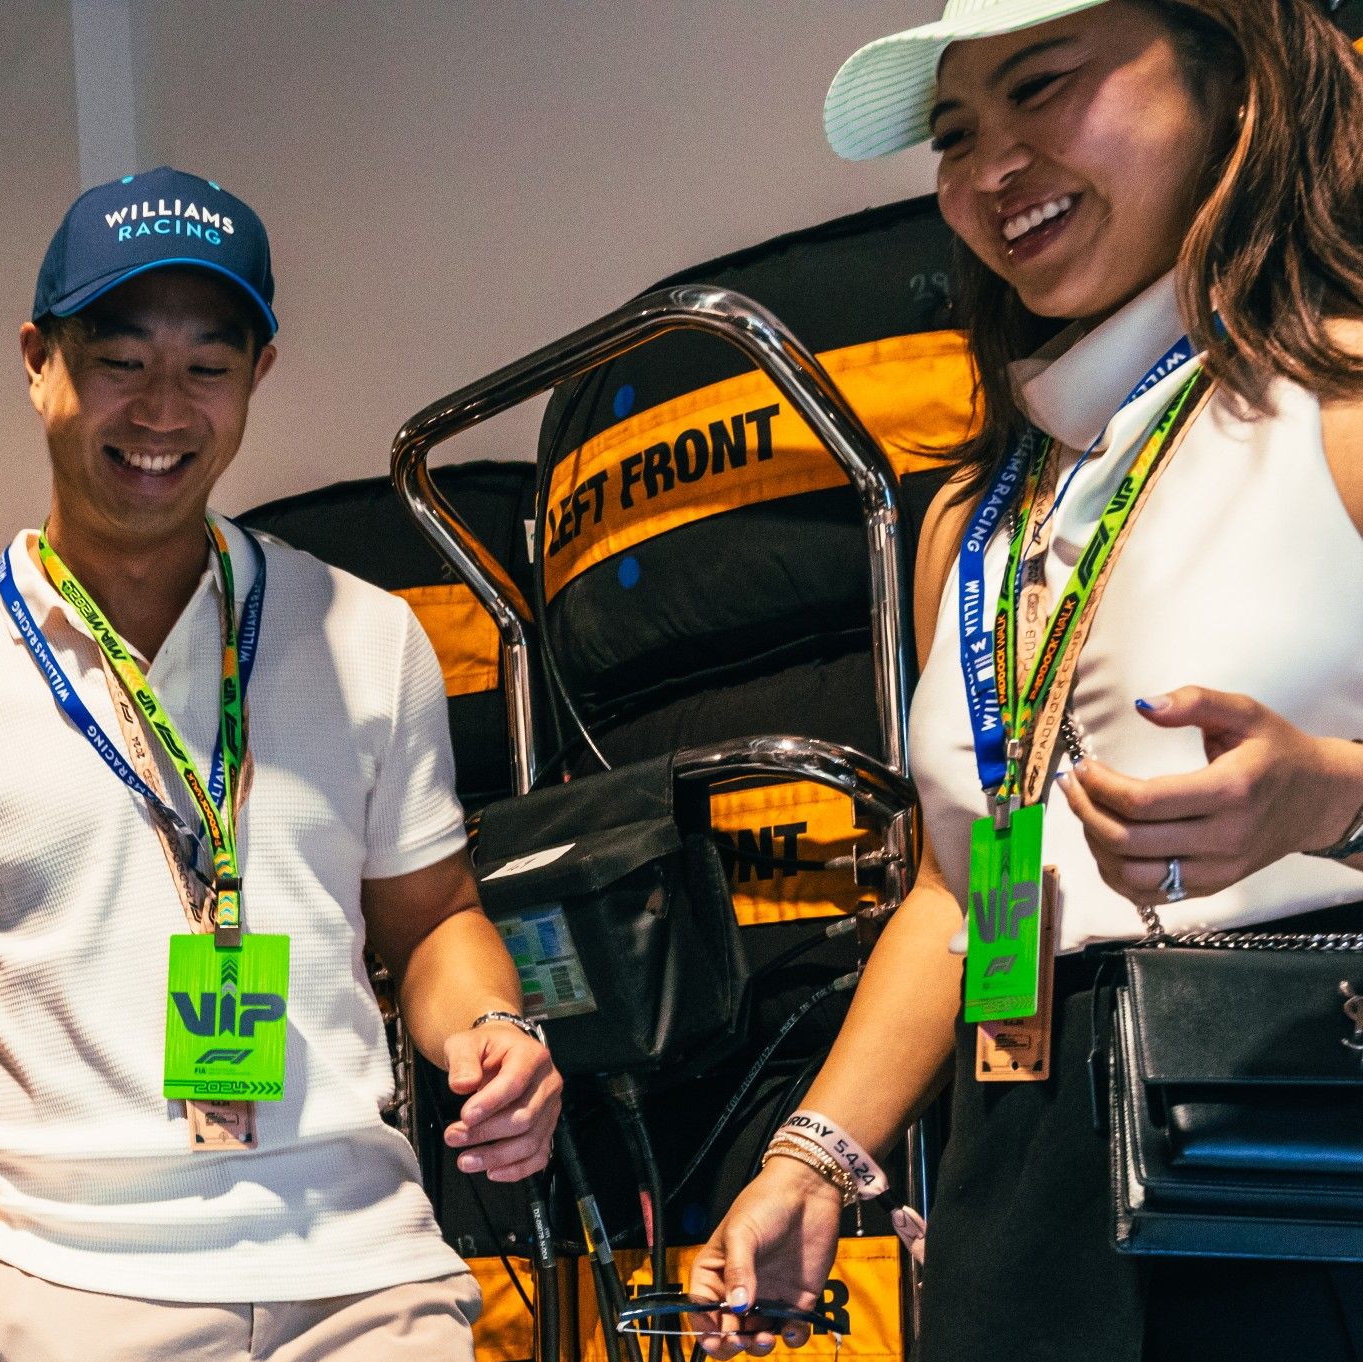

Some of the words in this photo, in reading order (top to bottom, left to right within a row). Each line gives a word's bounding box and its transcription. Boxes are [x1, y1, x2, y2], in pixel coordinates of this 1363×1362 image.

[104, 198, 235, 235] WILLIAMS
[118, 218, 222, 246] RACING
[548, 470, 609, 557] LEFT
[620, 402, 780, 510] FRONT
[1106, 477, 1134, 514] VIP
[963, 579, 980, 638] WILLIA
[136, 688, 157, 718] VIP
[972, 880, 1040, 944] VIP
[170, 991, 287, 1038] VIP
[194, 1080, 246, 1094] 2024
[833, 1138, 877, 1187] 5.4.24
